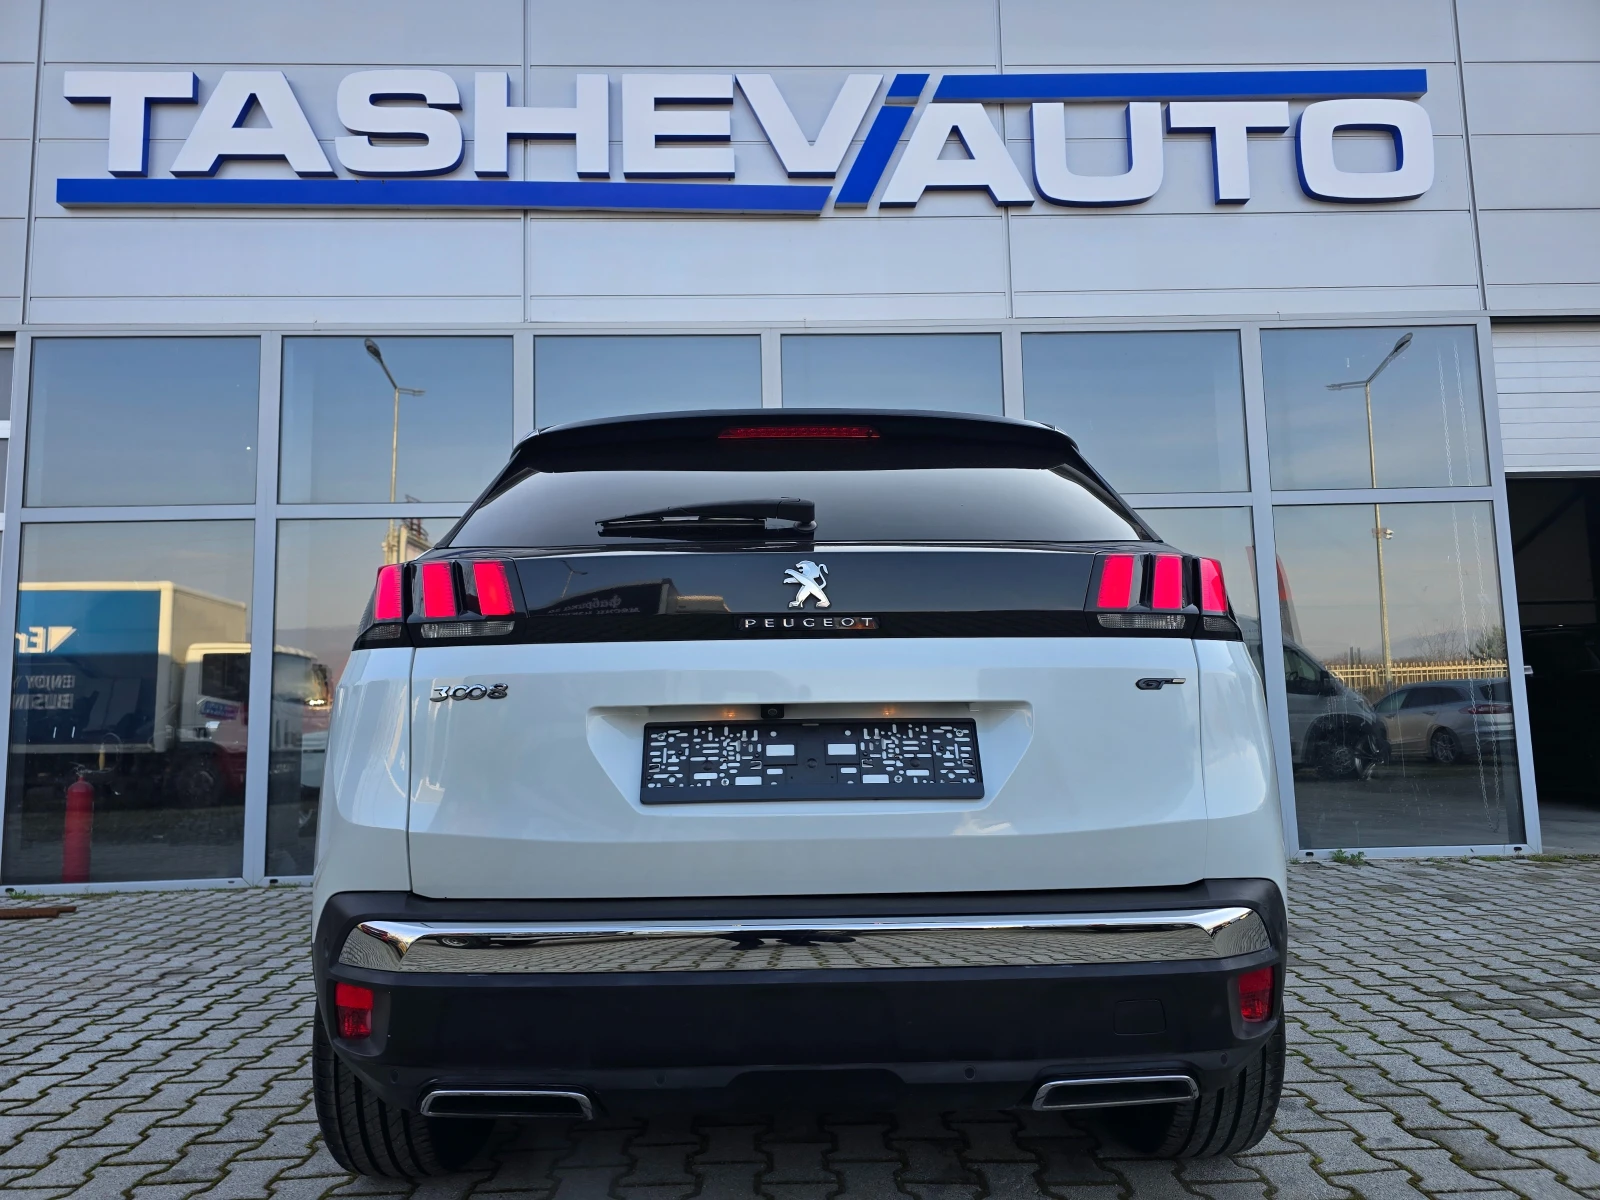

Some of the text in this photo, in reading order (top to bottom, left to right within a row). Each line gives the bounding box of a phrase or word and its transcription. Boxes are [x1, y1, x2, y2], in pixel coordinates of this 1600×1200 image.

[63, 69, 1436, 206] TASHEV AUTO
[744, 617, 873, 628] PEUGEOT
[1136, 677, 1180, 690] GT
[429, 682, 509, 703] 3008
